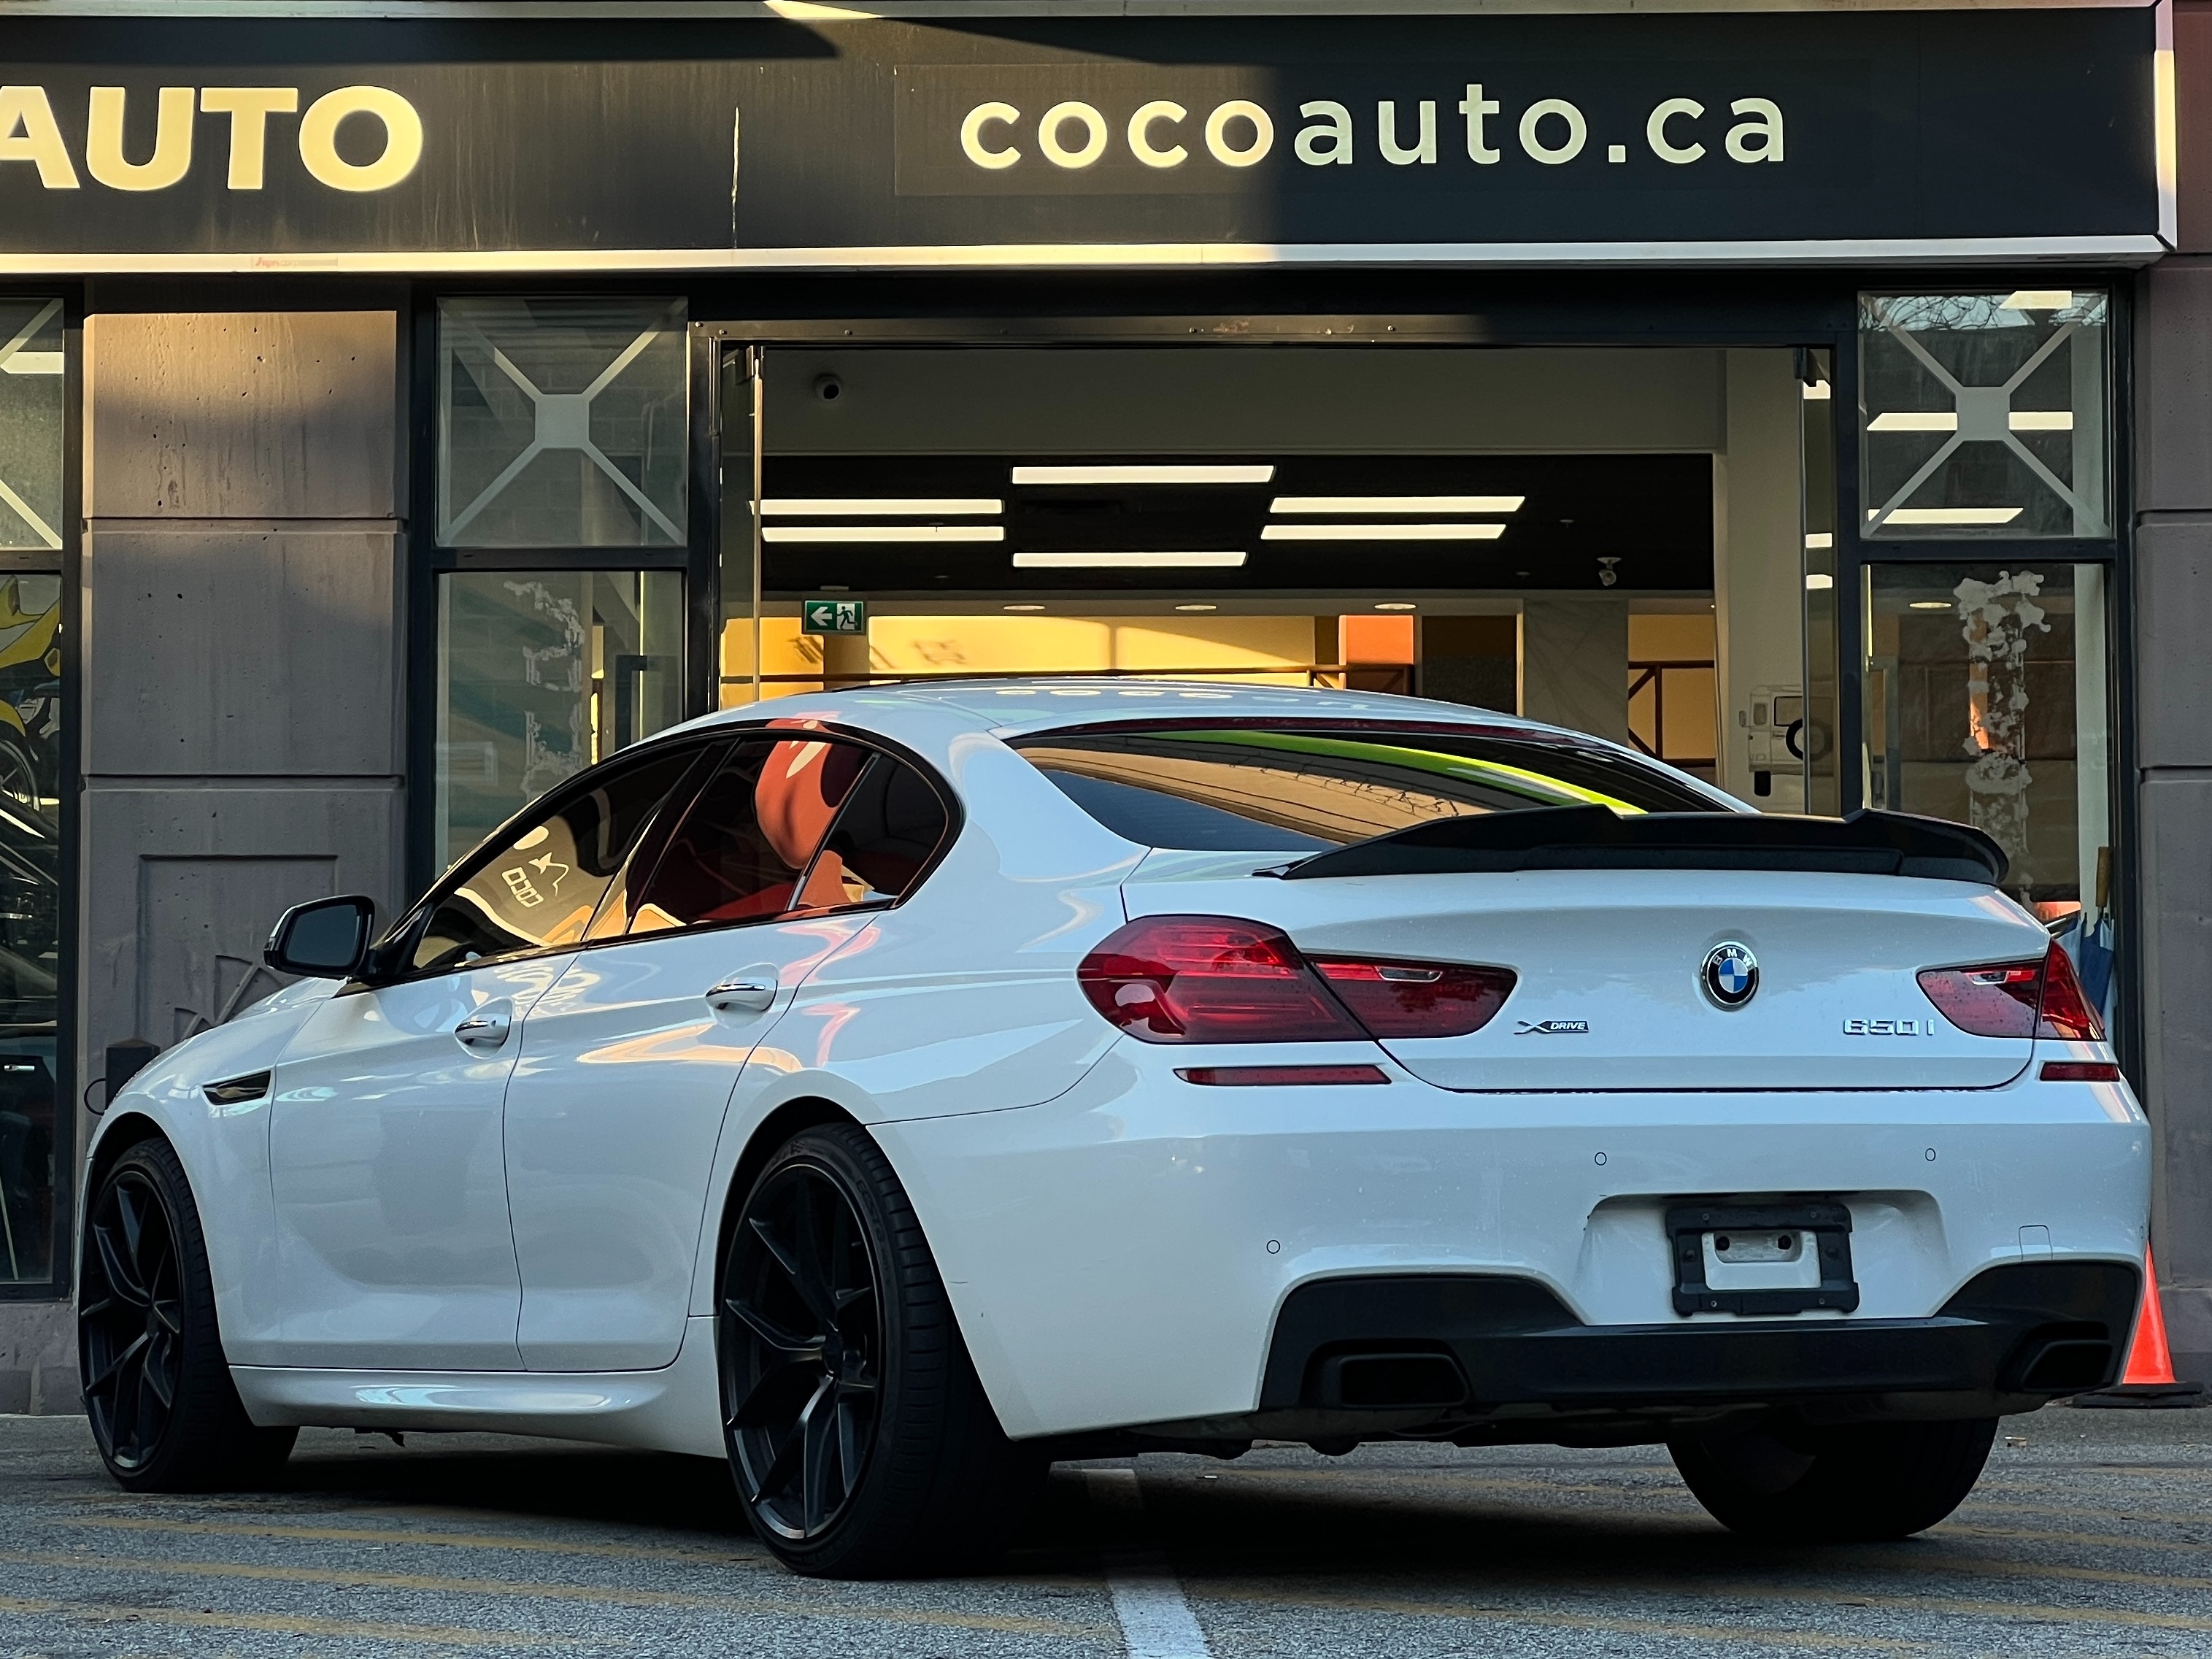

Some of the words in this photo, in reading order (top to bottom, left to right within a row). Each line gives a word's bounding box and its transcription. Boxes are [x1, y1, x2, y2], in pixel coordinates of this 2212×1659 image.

[0, 85, 424, 192] AUTO
[960, 83, 1786, 169] cocoauto.ca
[1712, 948, 1753, 967] BMW
